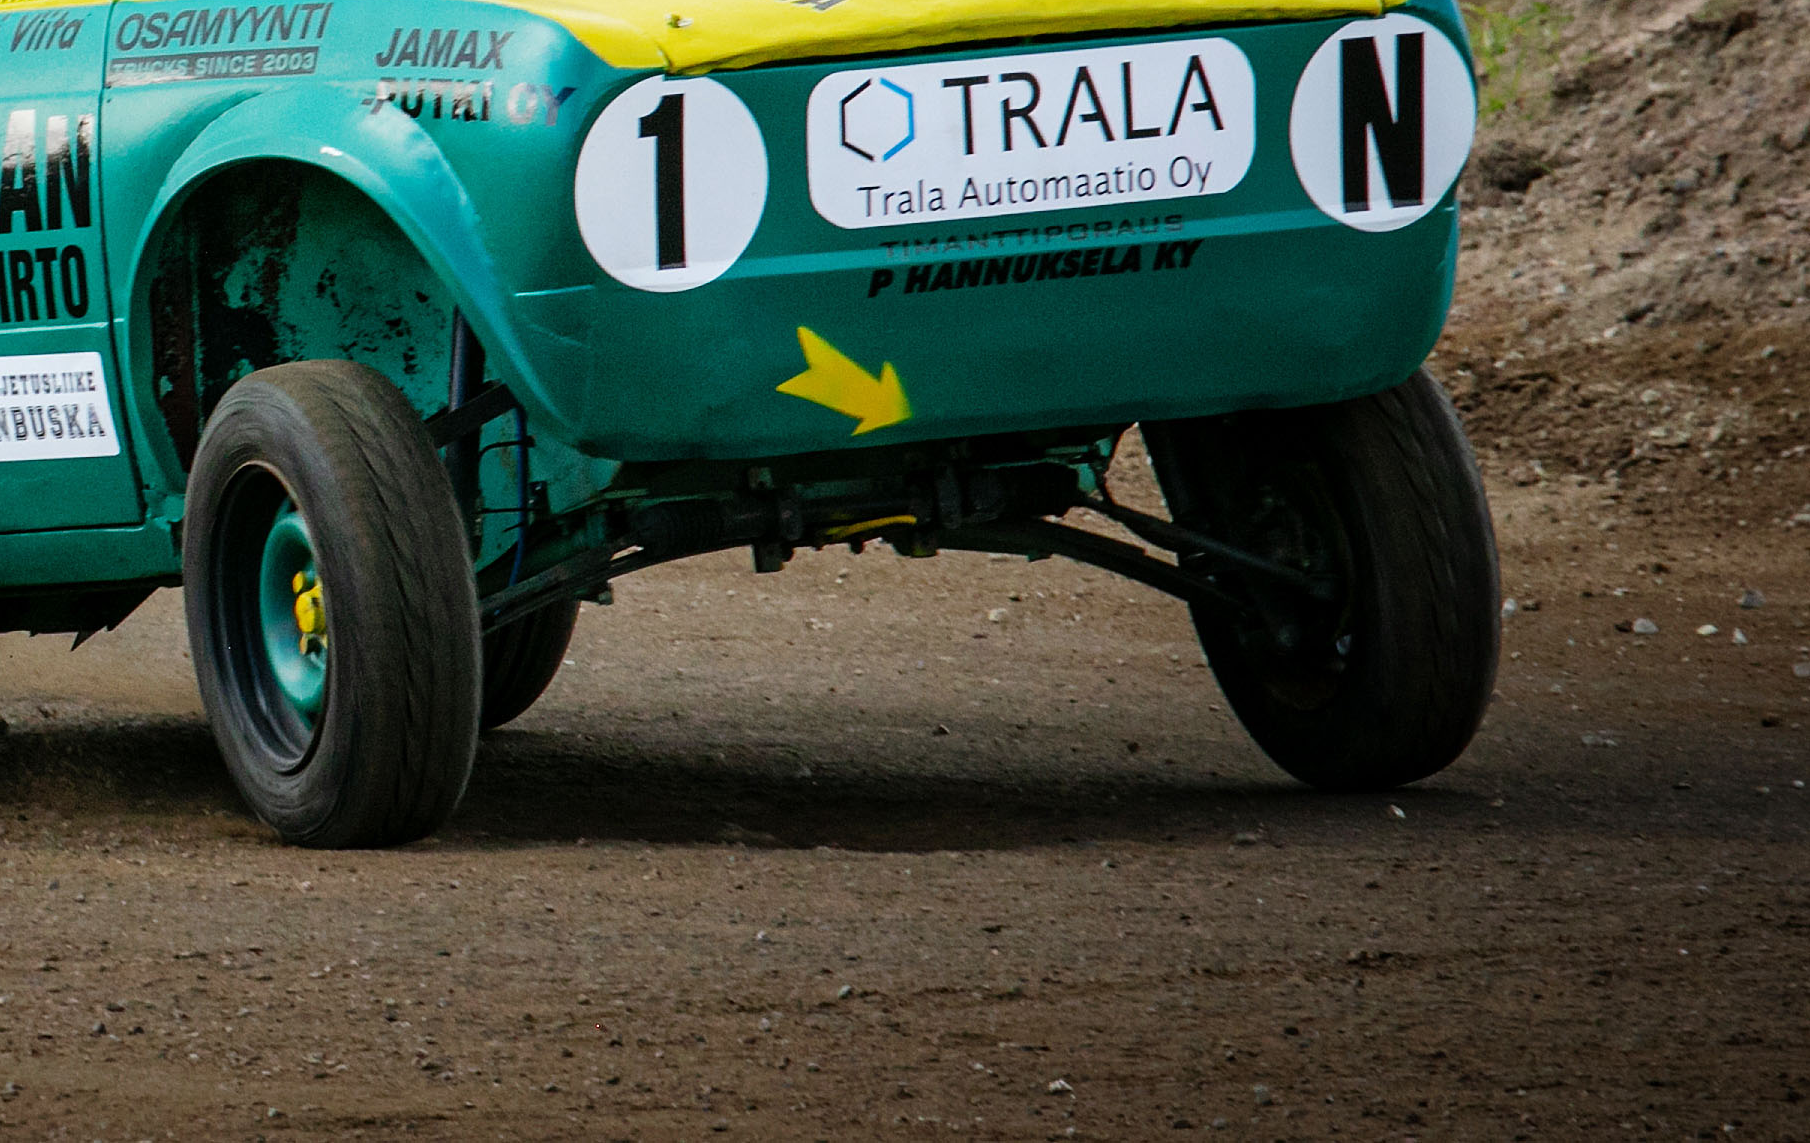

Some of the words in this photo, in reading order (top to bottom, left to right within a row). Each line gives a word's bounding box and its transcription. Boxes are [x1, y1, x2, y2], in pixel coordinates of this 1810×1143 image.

[115, 2, 333, 51] OSAMYYNTI
[376, 28, 513, 70] JAMAX
[194, 55, 257, 75] SINCE
[262, 48, 317, 73] 2003
[942, 54, 1224, 156] TRALA
[1341, 32, 1426, 214] N
[638, 93, 689, 271] 1
[857, 178, 945, 218] Trala
[958, 162, 1156, 208] Automaatio
[1169, 155, 1213, 194] Oy
[867, 269, 895, 298] P
[903, 244, 1142, 294] HANNUKSELA
[1152, 238, 1206, 270] KY
